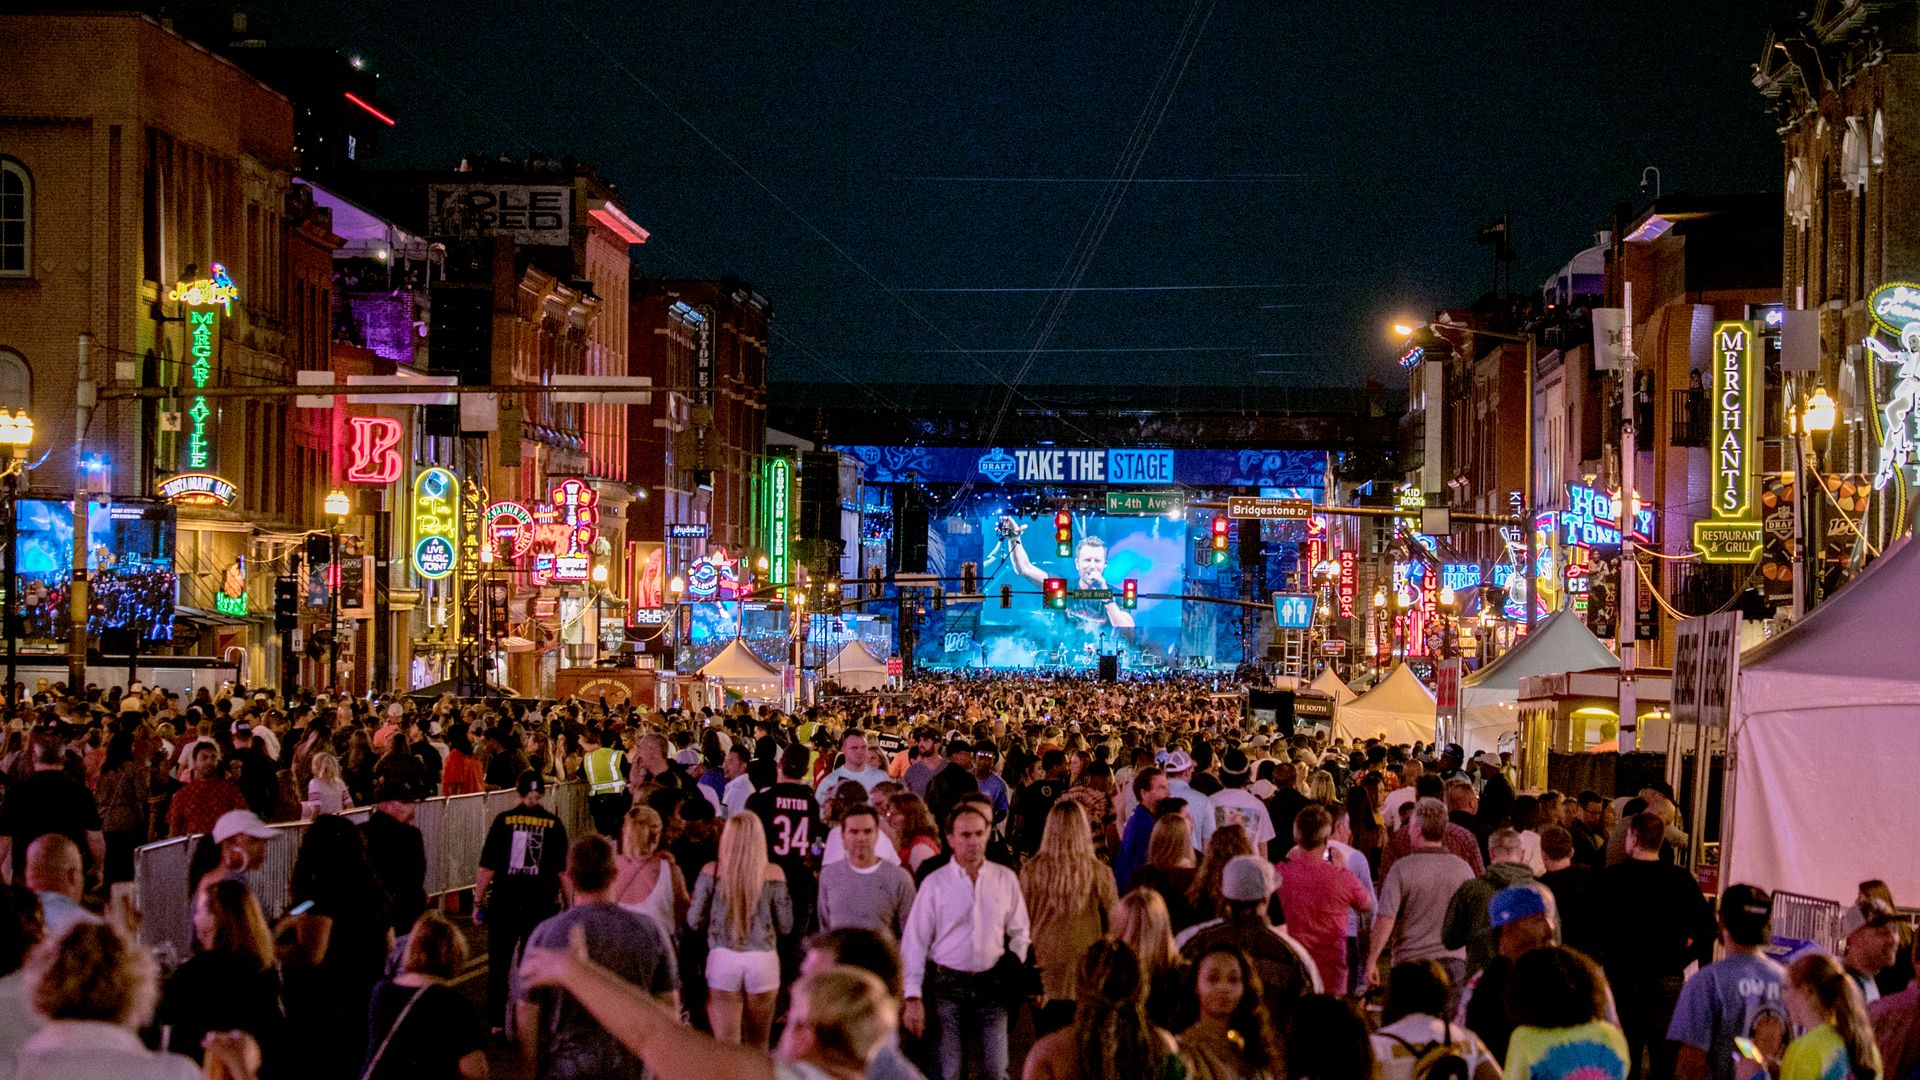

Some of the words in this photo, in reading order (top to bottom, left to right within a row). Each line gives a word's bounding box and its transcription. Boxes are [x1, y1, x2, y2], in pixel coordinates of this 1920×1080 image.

[1721, 331, 1743, 510] MERCHANTS
[1015, 451, 1064, 481] TAKE
[1068, 451, 1105, 481] THE
[1114, 453, 1168, 480] STAGE
[215, 481, 233, 500] BAR
[1404, 488, 1420, 497] KID
[420, 496, 451, 514] Tin
[1111, 498, 1142, 509] N-4th
[1234, 505, 1295, 517] Bridgestone
[1297, 508, 1307, 516] Dr
[1572, 485, 1651, 535] HOY
[417, 515, 455, 538] Roof
[1769, 520, 1794, 529] DRAF
[1702, 530, 1761, 541] RESTAURANT
[427, 545, 443, 554] LIVE
[1710, 541, 1718, 551] &
[1725, 542, 1752, 552] GRILL
[421, 554, 449, 562] MUSIC
[422, 562, 447, 571] JOINT
[1341, 552, 1354, 584] ROCK
[1605, 591, 1616, 602] 25
[1604, 606, 1614, 617] 27
[1294, 703, 1305, 711] THE
[1306, 704, 1327, 713] SOUTH
[776, 796, 809, 811] PAYTON
[505, 814, 555, 829] SECURITY
[773, 814, 810, 857] 34
